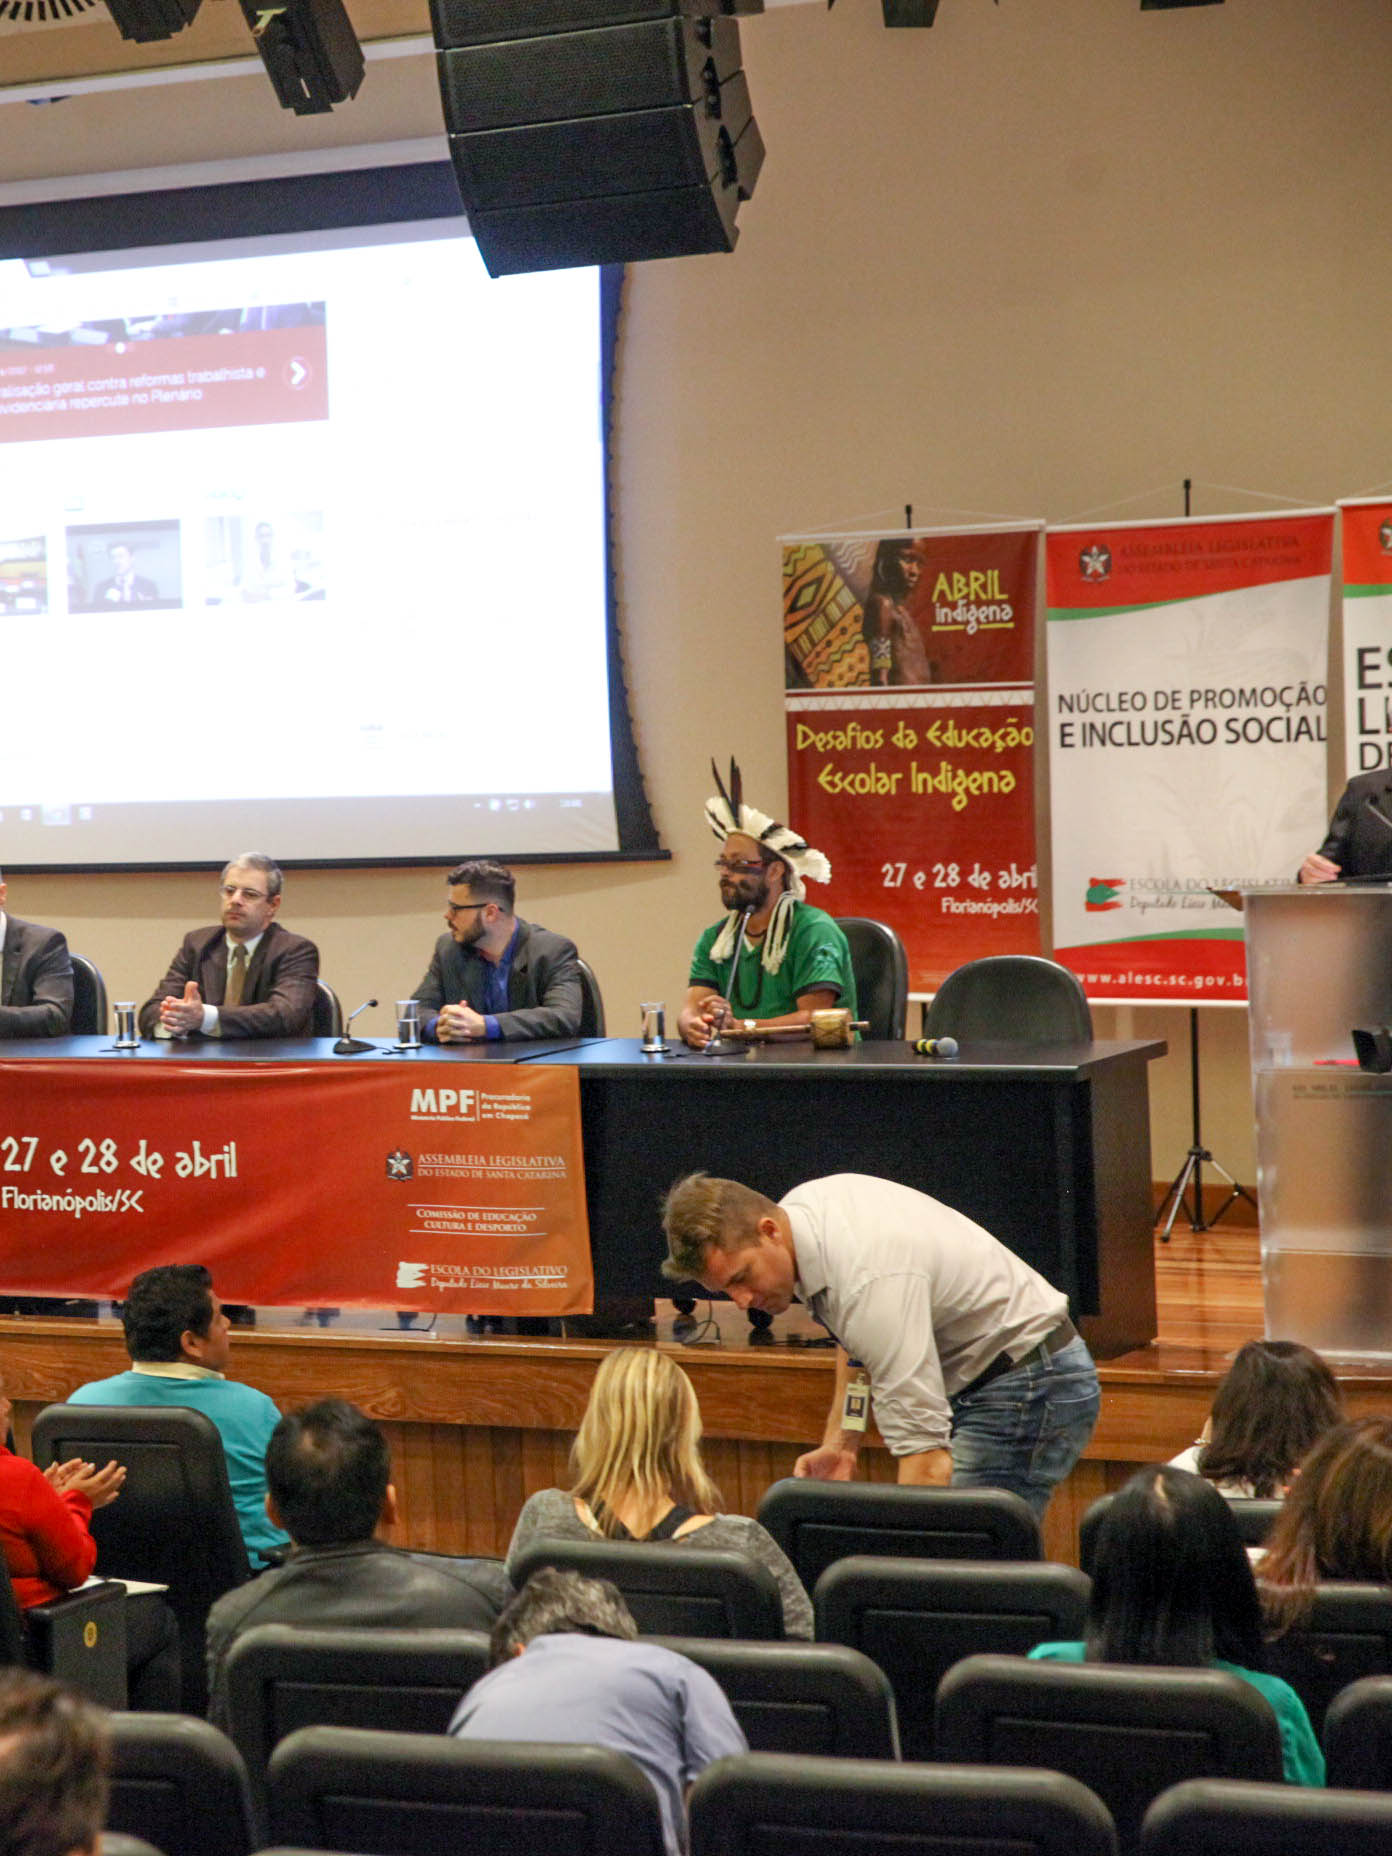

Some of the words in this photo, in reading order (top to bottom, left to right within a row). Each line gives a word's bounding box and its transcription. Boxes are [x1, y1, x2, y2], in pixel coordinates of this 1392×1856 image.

[932, 569, 1009, 602] ABRIL
[1058, 689, 1147, 714] NÚCLEO
[1154, 690, 1182, 711] DE
[1189, 681, 1327, 713] PROMOÇÃO
[796, 721, 884, 752] Desafios
[891, 720, 918, 749] da
[925, 717, 1035, 752] Educação
[1060, 722, 1075, 748] E
[1082, 714, 1218, 748] INCLUSÃO
[1224, 715, 1327, 745] SOCIAL
[817, 762, 903, 795] Escolar
[881, 862, 907, 888] 27
[912, 871, 926, 890] e
[932, 862, 960, 888] 28
[967, 863, 992, 890] de
[410, 1088, 475, 1114] MPF
[1, 1136, 39, 1172] 27
[49, 1149, 68, 1176] e
[78, 1138, 118, 1174] 28
[129, 1139, 164, 1179] de
[175, 1141, 238, 1179] abril
[418, 1154, 486, 1166] ASSEMBLEIA
[489, 1155, 566, 1168] LEGISLATIVA
[1, 1185, 145, 1218] Florianópolis/SC
[430, 1264, 469, 1275] ESCOLA
[494, 1265, 568, 1277] LEGISLATIVO
